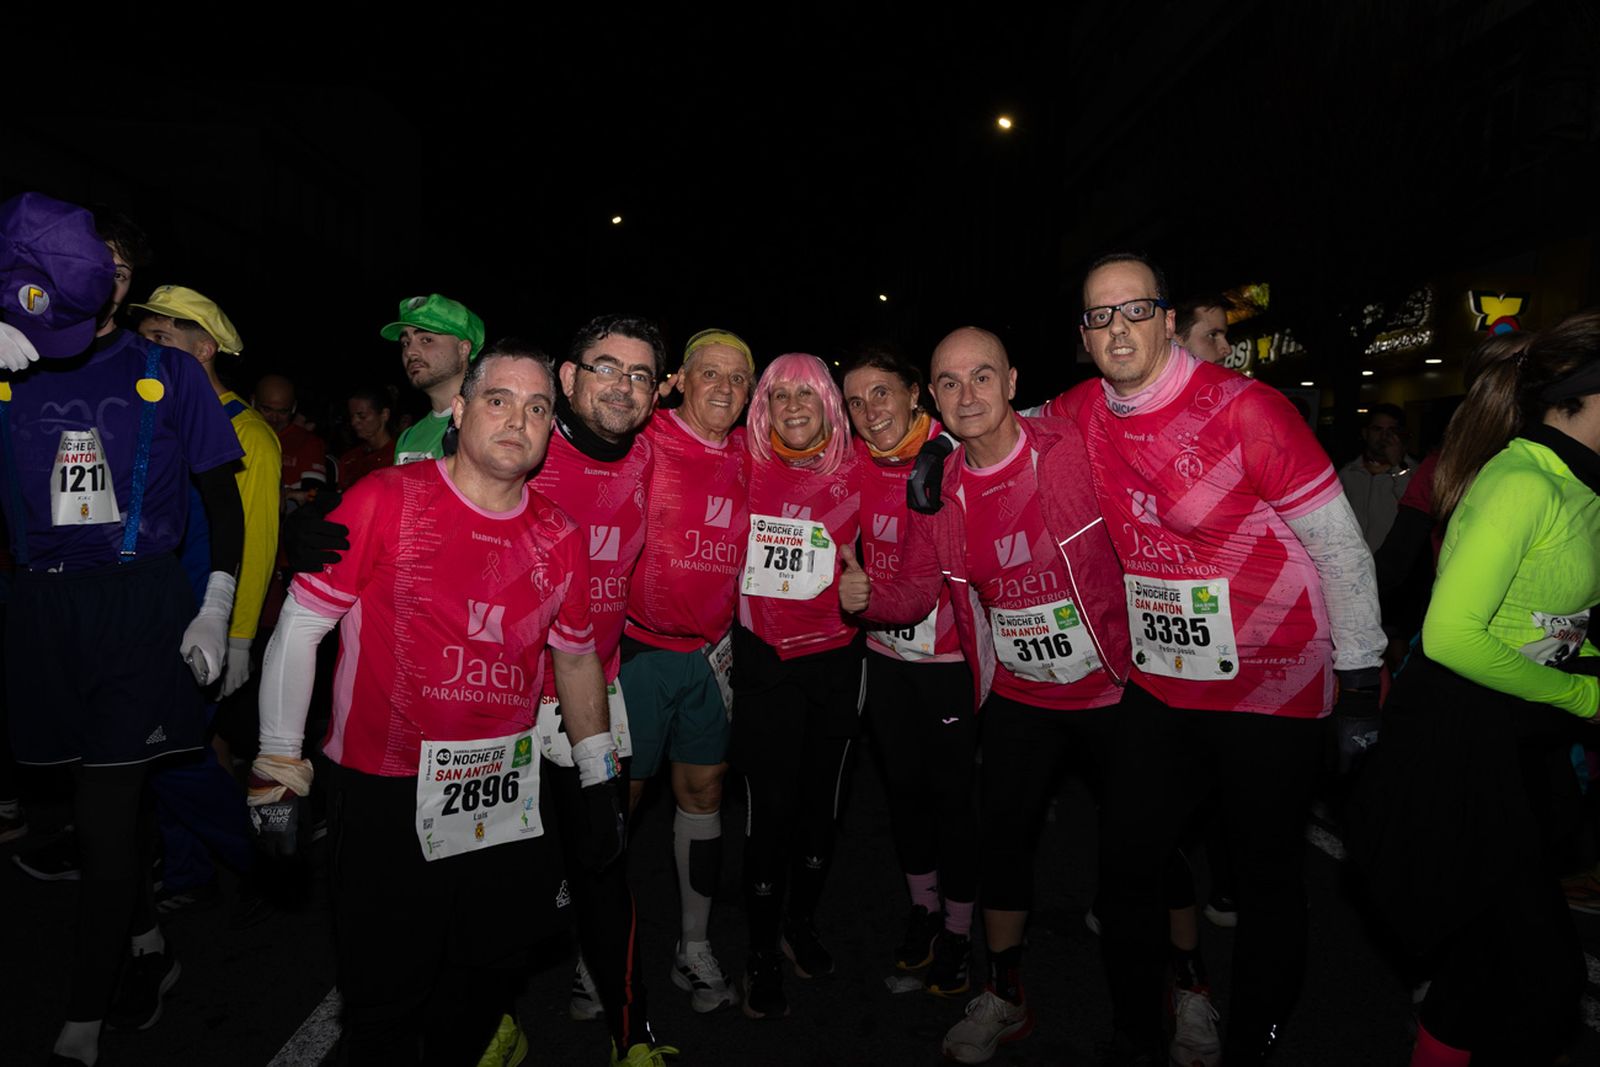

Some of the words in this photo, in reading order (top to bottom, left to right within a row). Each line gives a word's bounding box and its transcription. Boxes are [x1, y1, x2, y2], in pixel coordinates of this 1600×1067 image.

[472, 531, 501, 546] luanvi
[755, 533, 772, 544] SAN
[773, 536, 804, 546] ANTÓN
[766, 525, 792, 535] NOCHE
[793, 527, 805, 537] DE
[685, 529, 738, 564] Jaén
[1122, 522, 1198, 564] Jaén
[763, 544, 816, 574] 7381
[866, 542, 900, 572] Jaé
[1161, 563, 1221, 577] INTERIOR
[590, 568, 628, 601] aén
[989, 568, 1058, 602] Jaén
[1142, 588, 1168, 602] NOCHE
[1169, 592, 1182, 603] DE
[1135, 598, 1151, 611] SAN
[1152, 601, 1183, 615] ANTÓN
[1001, 627, 1018, 637] SAN
[1018, 624, 1050, 637] ANTÓN
[1006, 617, 1033, 627] NOCHE
[1034, 615, 1047, 624] DE
[1142, 612, 1211, 647] 3335
[1013, 633, 1073, 662] 3116
[441, 645, 525, 692] Jaén
[422, 685, 484, 702] PARAÍSO
[453, 752, 491, 765] NOCHE
[492, 749, 507, 760] DE
[435, 768, 463, 782] SAN
[463, 761, 503, 779] ANTÓN
[441, 771, 520, 816] 2896
[473, 811, 488, 820] Luis
